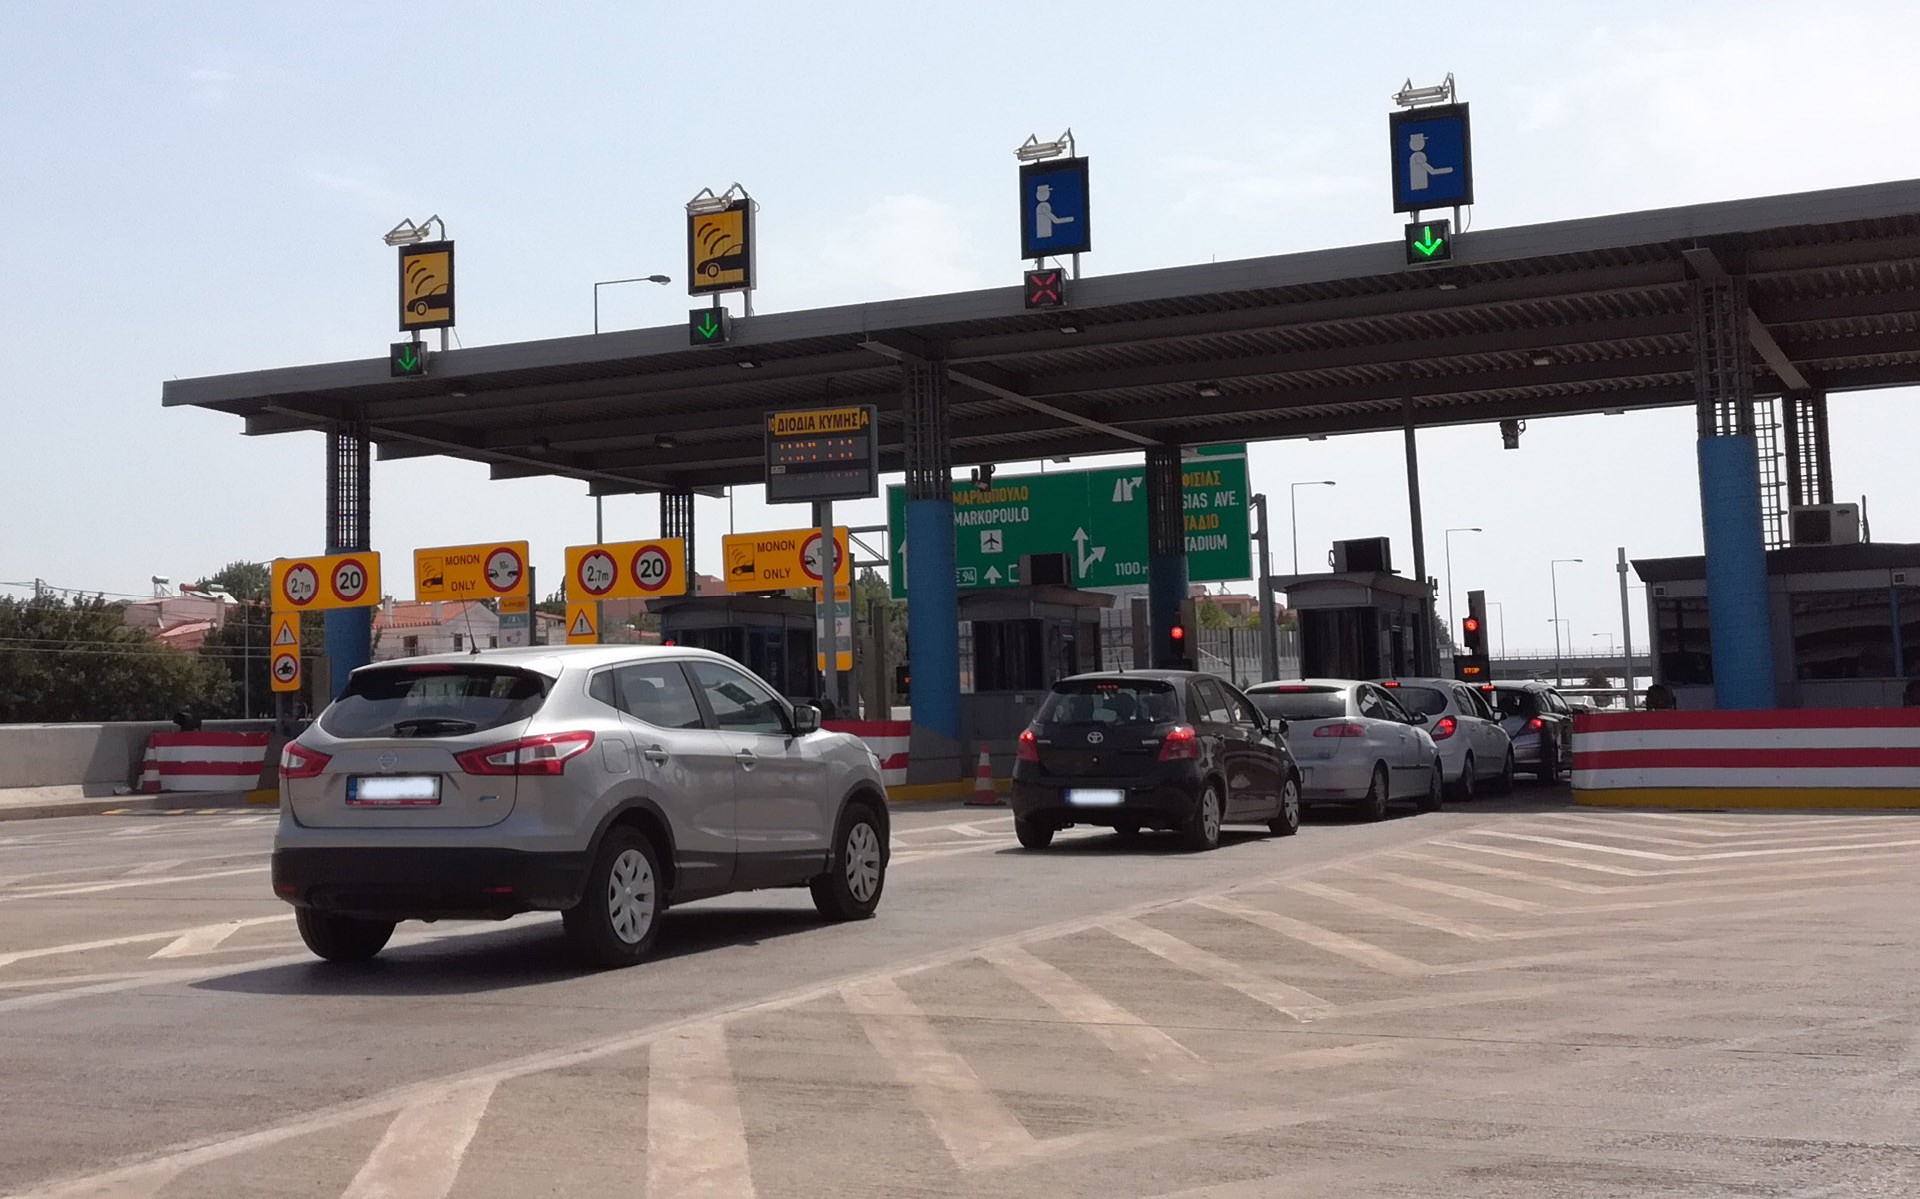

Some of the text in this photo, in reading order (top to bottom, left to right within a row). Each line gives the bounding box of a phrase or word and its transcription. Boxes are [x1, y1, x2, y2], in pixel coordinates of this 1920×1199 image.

[777, 416, 815, 433] ΔΙΟΔΙΑ
[819, 413, 857, 429] ΚΥΜΗΣ
[1214, 490, 1239, 507] AVE.
[953, 506, 1029, 526] MARKOPOULO
[640, 558, 664, 578] 20
[763, 567, 792, 580] ONLY
[962, 570, 975, 582] 94
[1115, 562, 1139, 576] 1100
[339, 571, 361, 590] 20
[451, 580, 476, 592] ONLY
